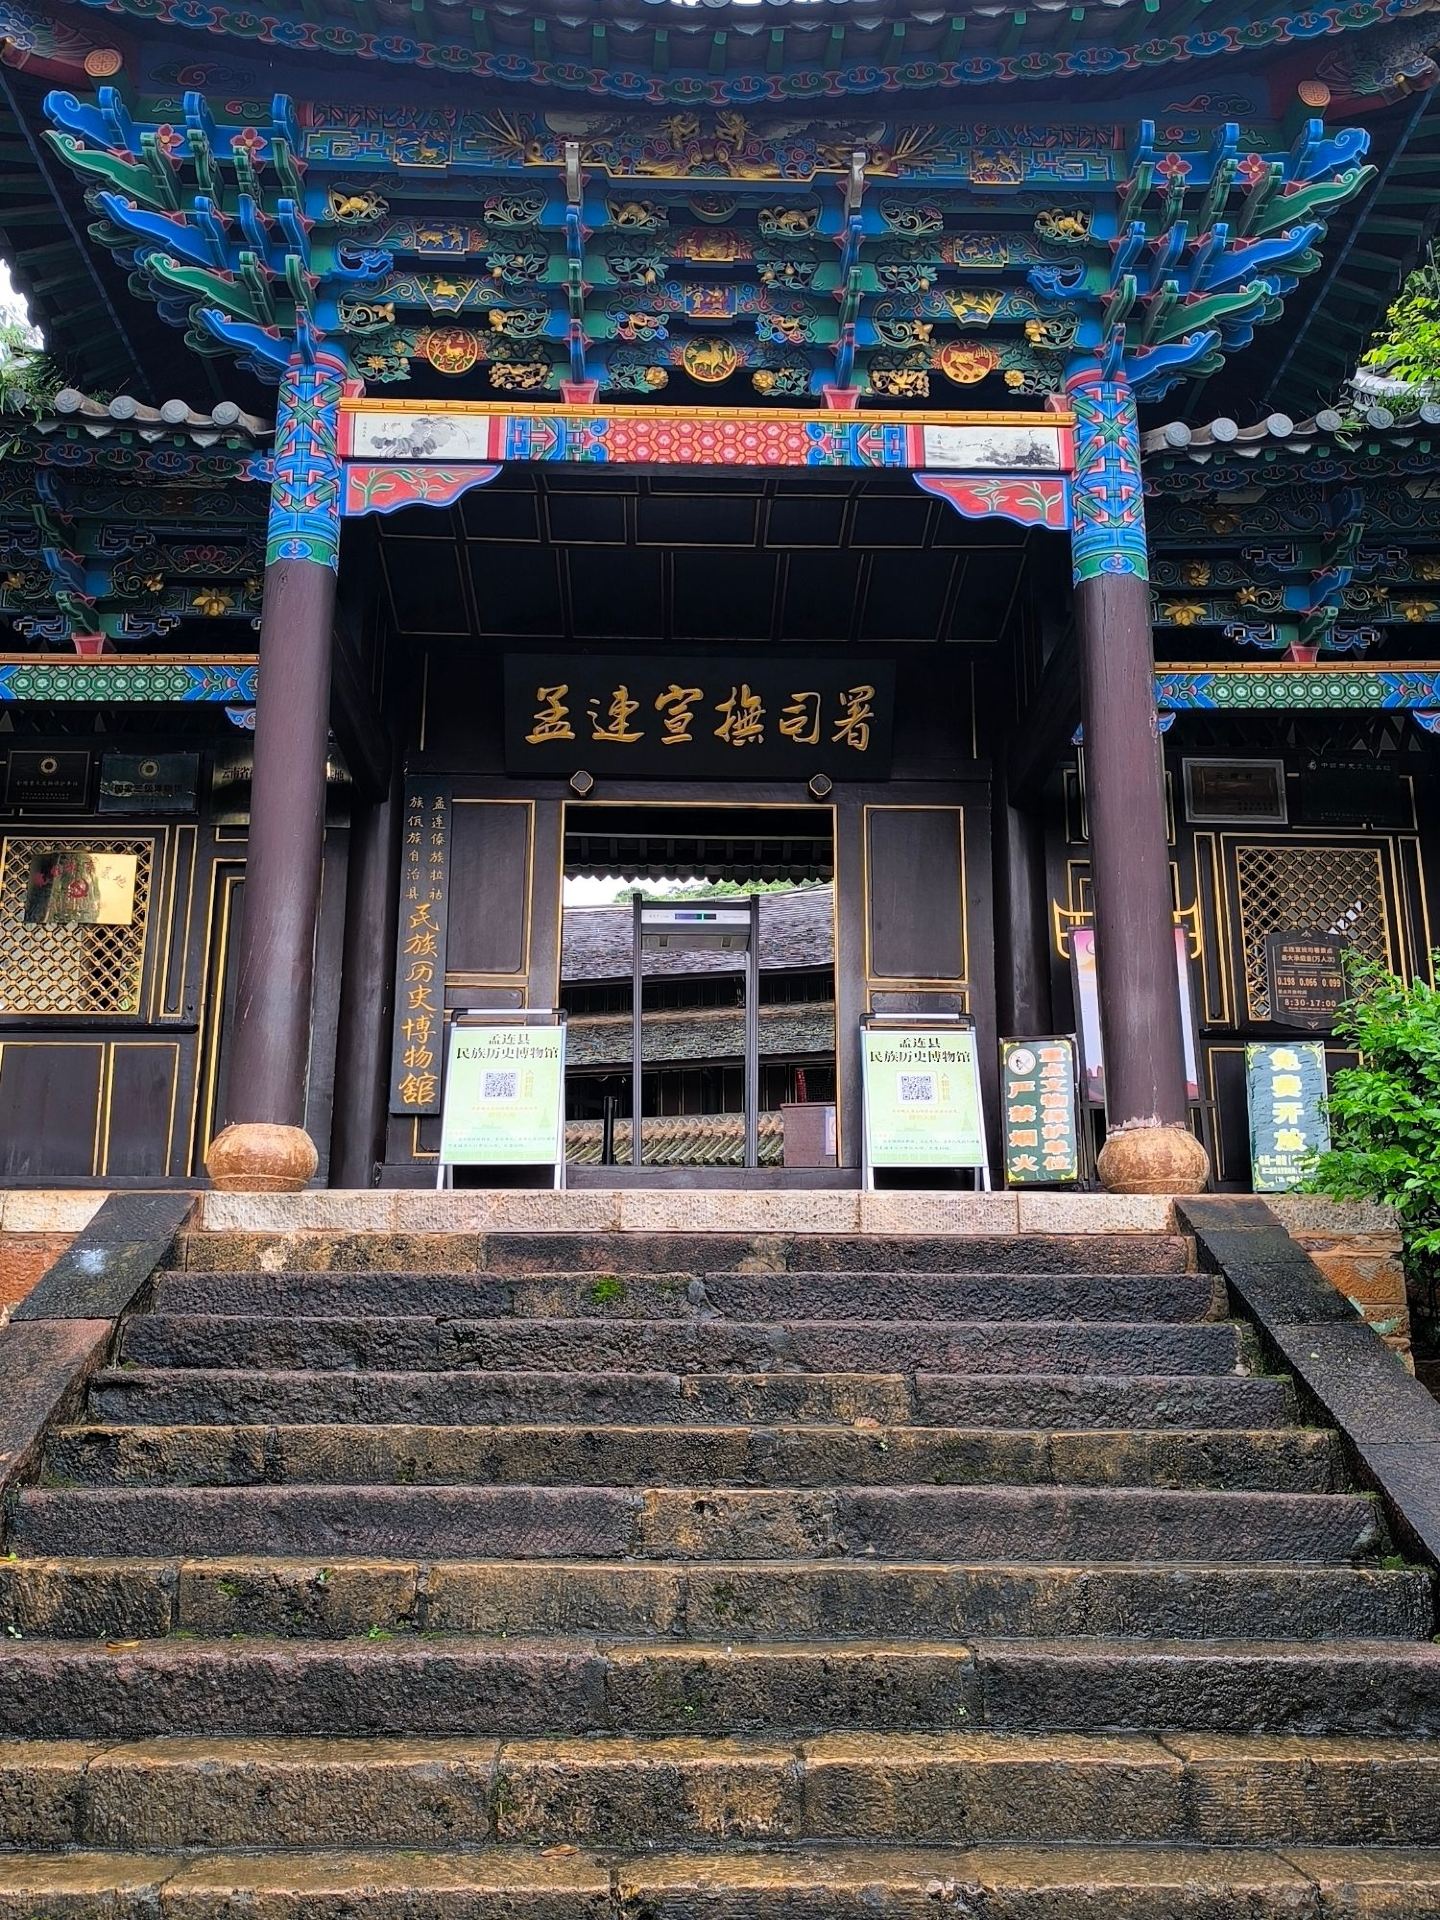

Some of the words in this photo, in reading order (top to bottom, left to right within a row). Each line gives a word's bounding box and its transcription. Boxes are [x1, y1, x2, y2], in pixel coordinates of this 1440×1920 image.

[1284, 999, 1337, 1008] 8:30-17:00
[488, 1033, 530, 1045] 孟连县
[899, 1037, 941, 1049] 孟连县
[456, 1047, 559, 1060] 民族历史博物馆
[870, 1051, 971, 1063] 民族历史博物馆
